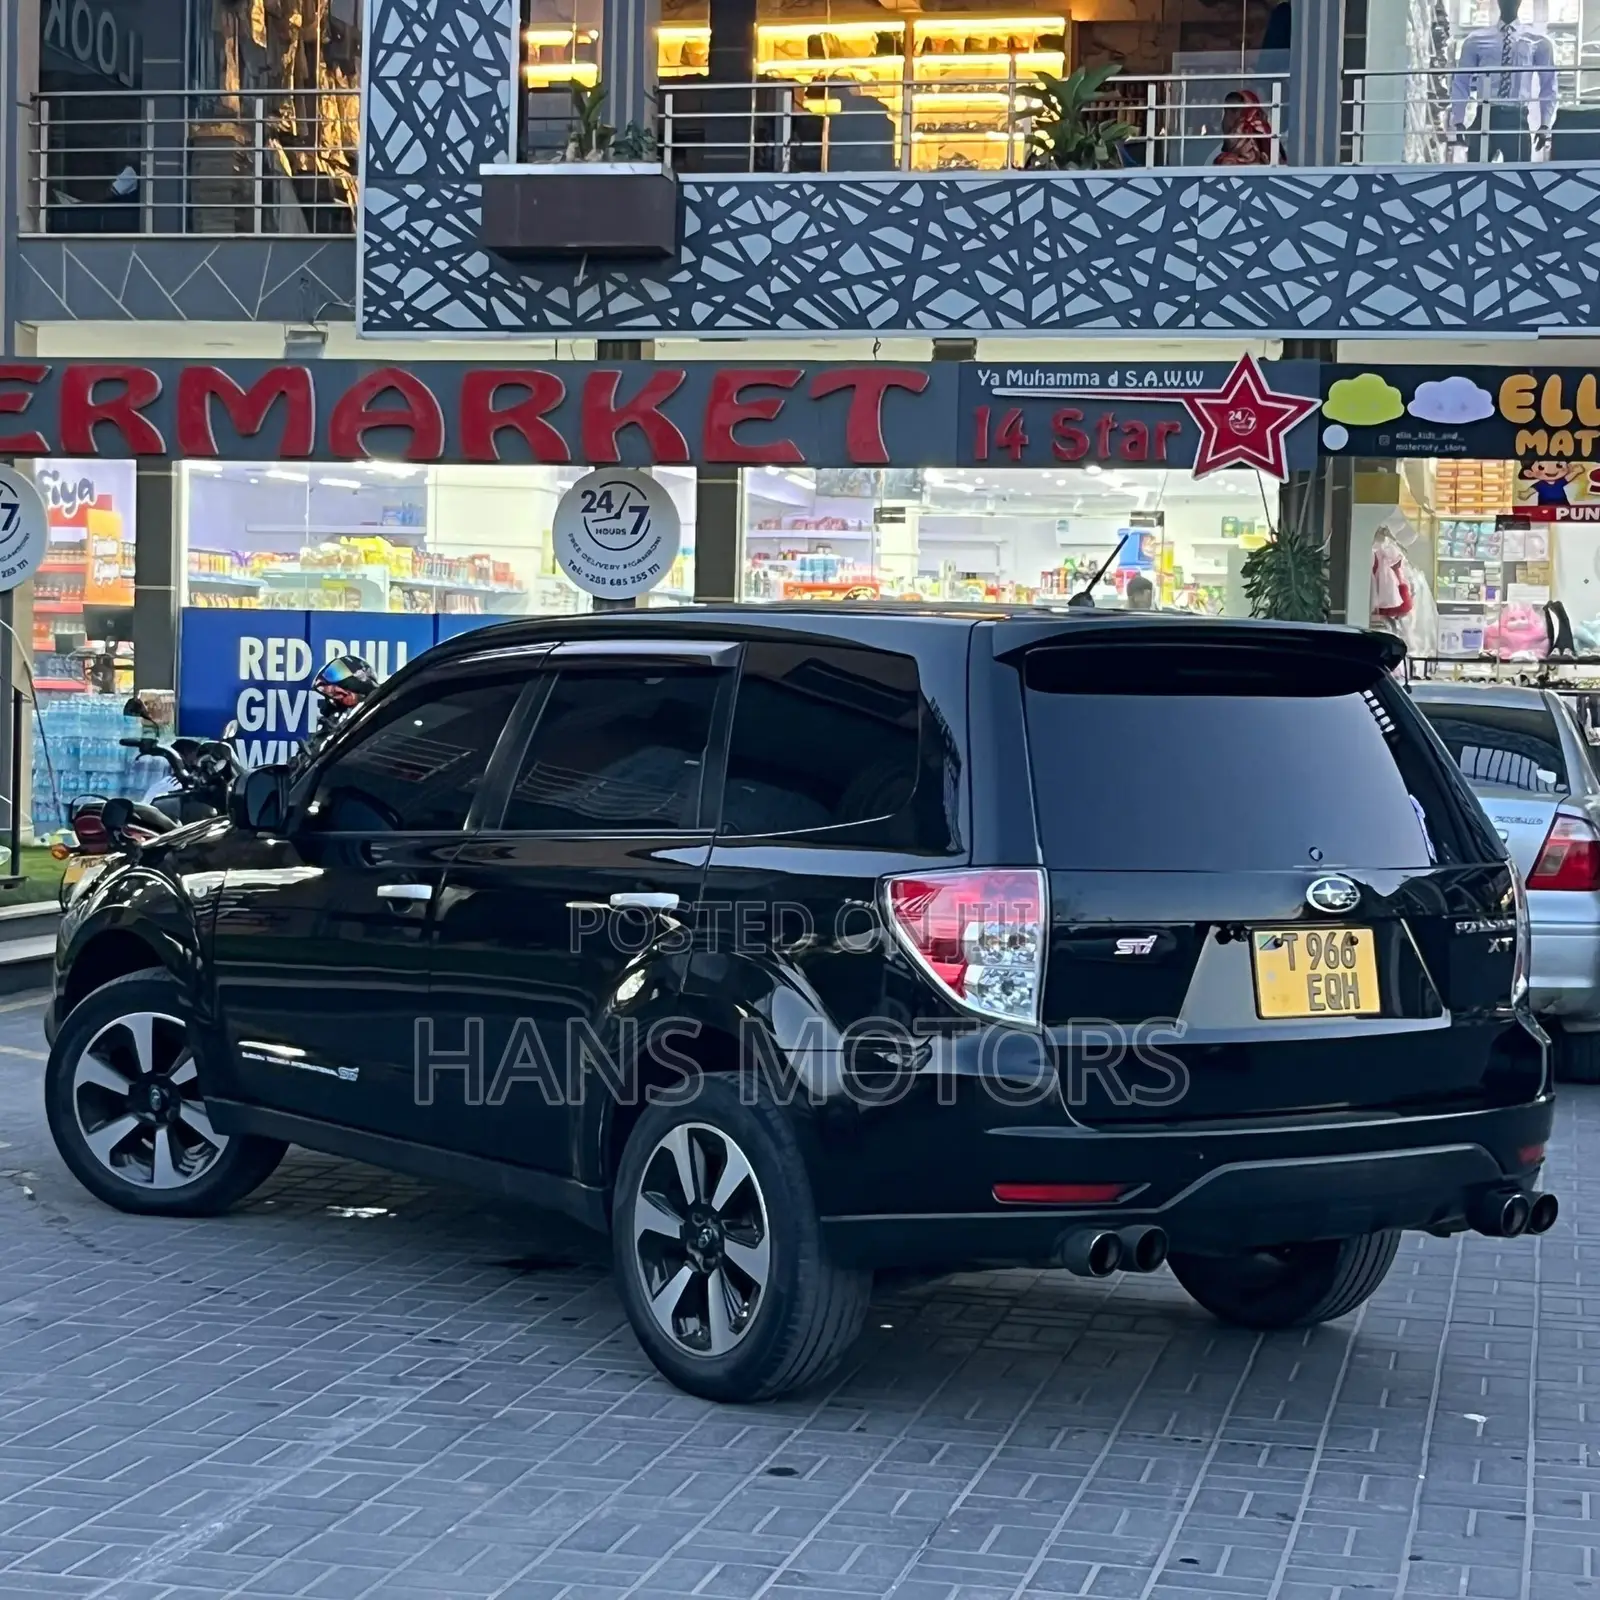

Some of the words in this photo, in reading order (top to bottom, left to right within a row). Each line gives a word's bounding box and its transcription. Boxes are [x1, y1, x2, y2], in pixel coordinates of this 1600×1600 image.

[978, 369, 999, 386] Ya
[1007, 369, 1100, 386] Muhamma
[1125, 370, 1204, 387] S.A.W.W
[973, 404, 1029, 460] 14
[1051, 406, 1182, 461] Star
[1515, 428, 1600, 457] MAT
[1555, 507, 1600, 521] PUN
[595, 528, 627, 536] HOURS
[239, 636, 312, 682] RED
[1281, 932, 1298, 971] T
[1306, 931, 1357, 970] 966
[1488, 936, 1514, 954] XT
[1306, 972, 1361, 1011] EQH
